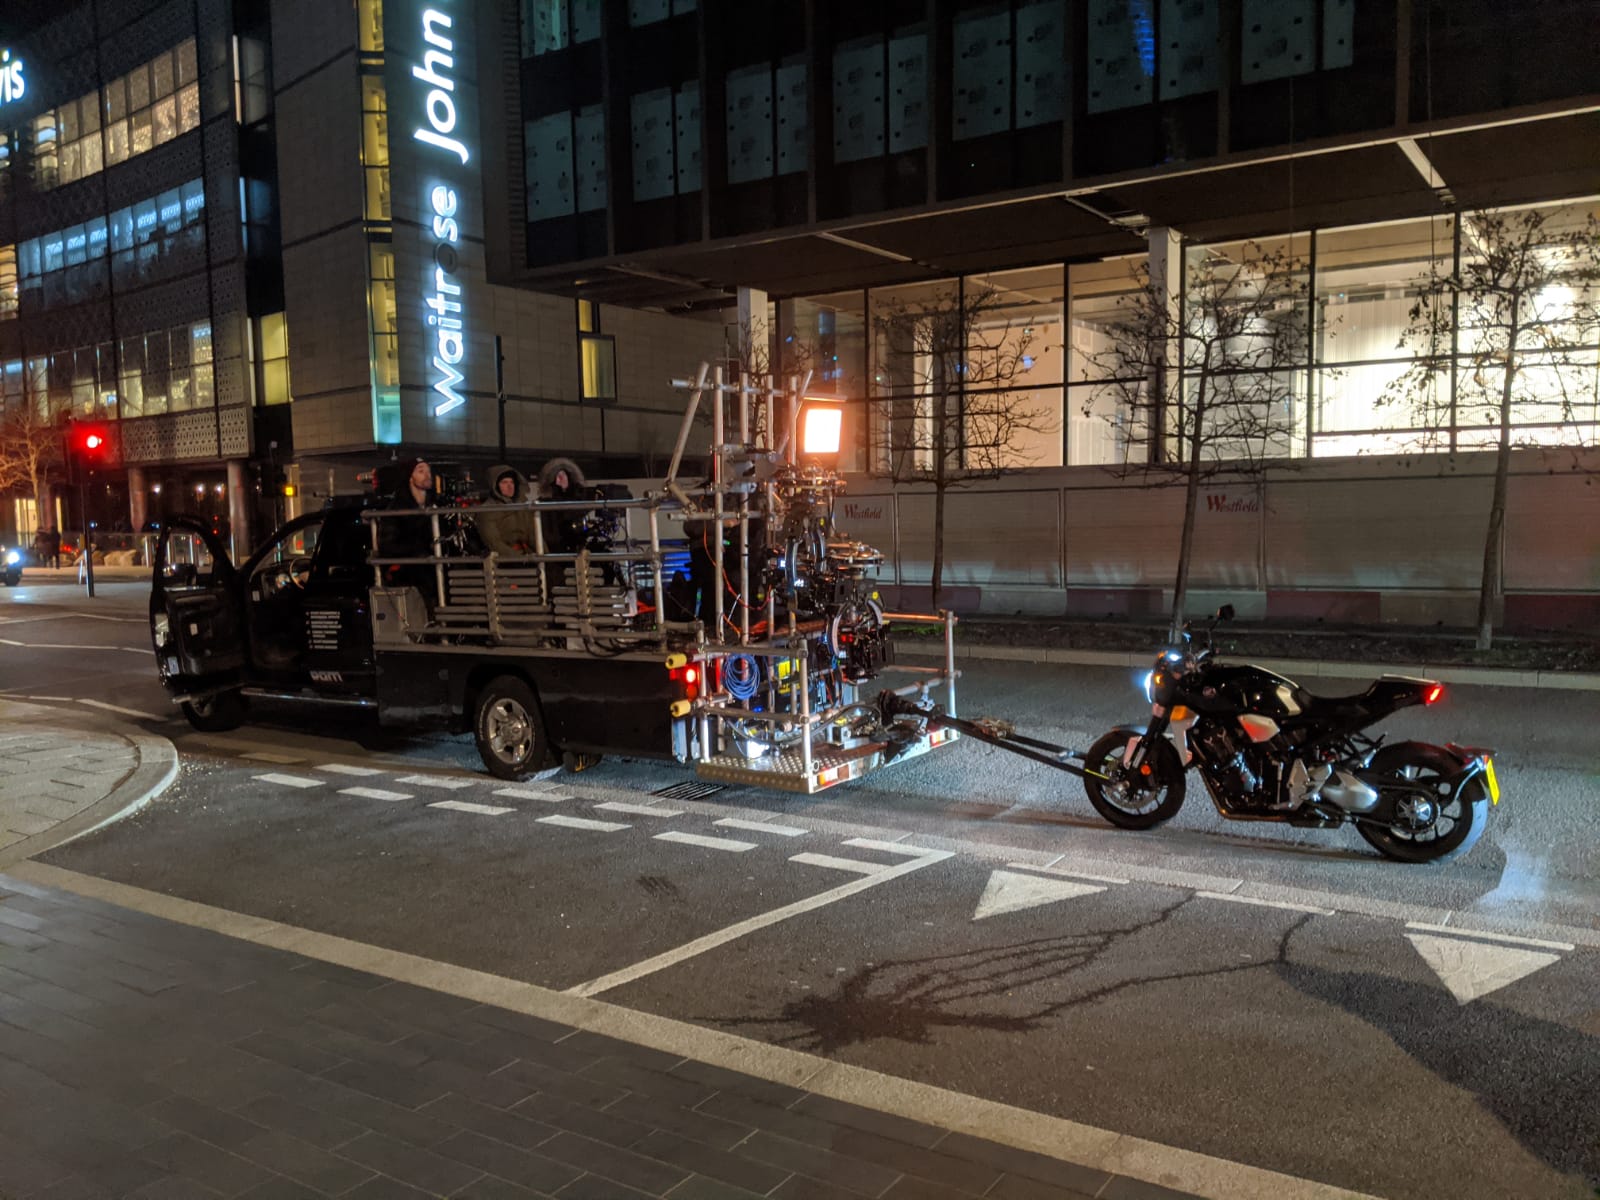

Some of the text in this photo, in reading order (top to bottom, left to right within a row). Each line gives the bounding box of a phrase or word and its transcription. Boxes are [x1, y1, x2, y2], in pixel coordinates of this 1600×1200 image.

[412, 8, 470, 417] Waitrose John
[844, 503, 883, 520] Westfield
[1206, 494, 1259, 513] Westfield
